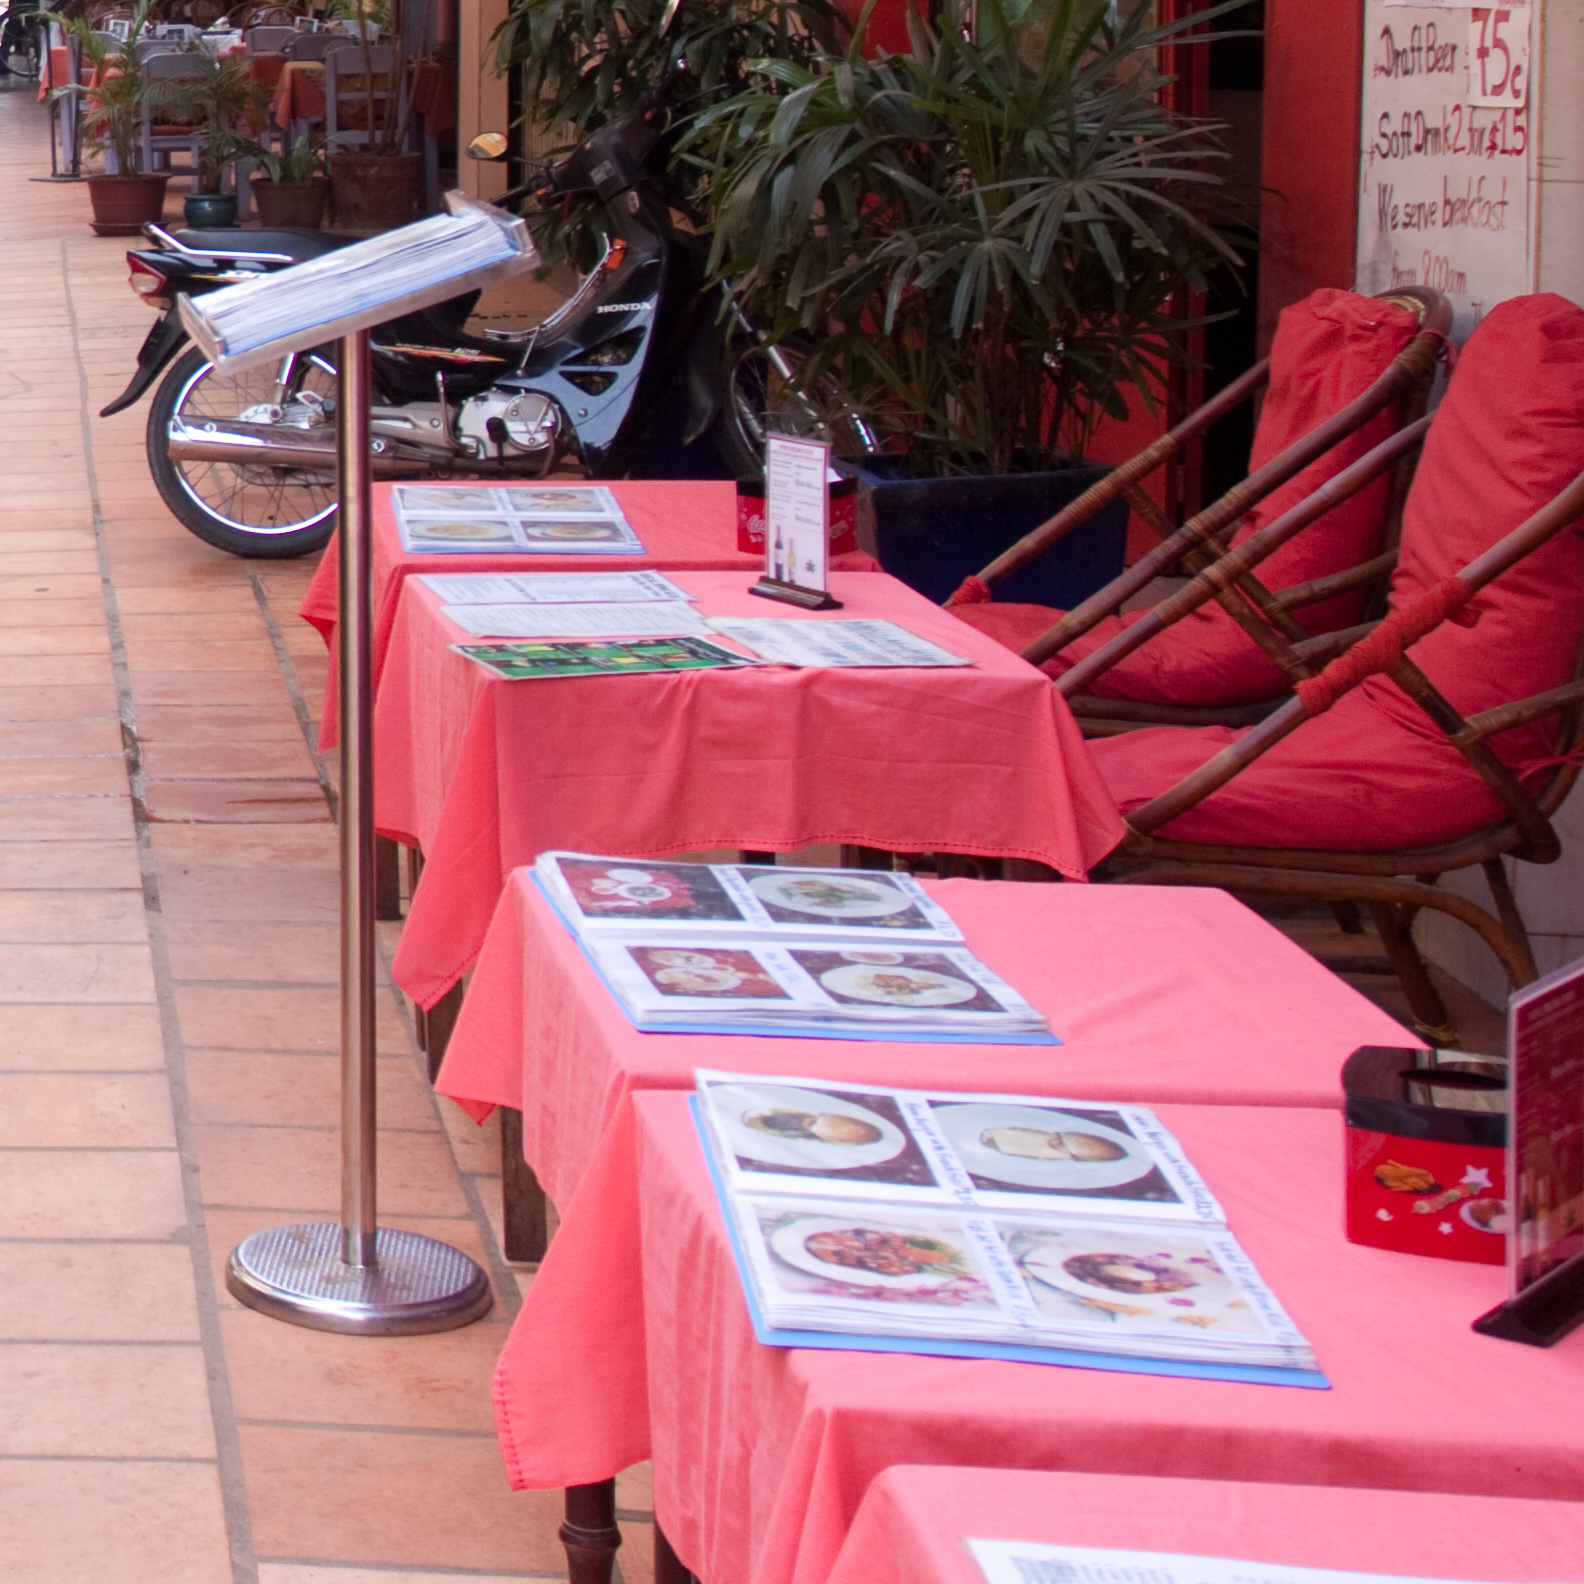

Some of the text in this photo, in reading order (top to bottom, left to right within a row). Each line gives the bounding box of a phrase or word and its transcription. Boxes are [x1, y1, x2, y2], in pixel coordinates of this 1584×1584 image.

[1379, 23, 1423, 80] Draft
[1425, 20, 1458, 75] Beer
[1374, 110, 1412, 160] Soft
[1413, 104, 1452, 157] Drink
[1451, 103, 1467, 155] 2
[1466, 106, 1486, 156] for
[1377, 181, 1400, 232] We
[1401, 200, 1438, 232] serve
